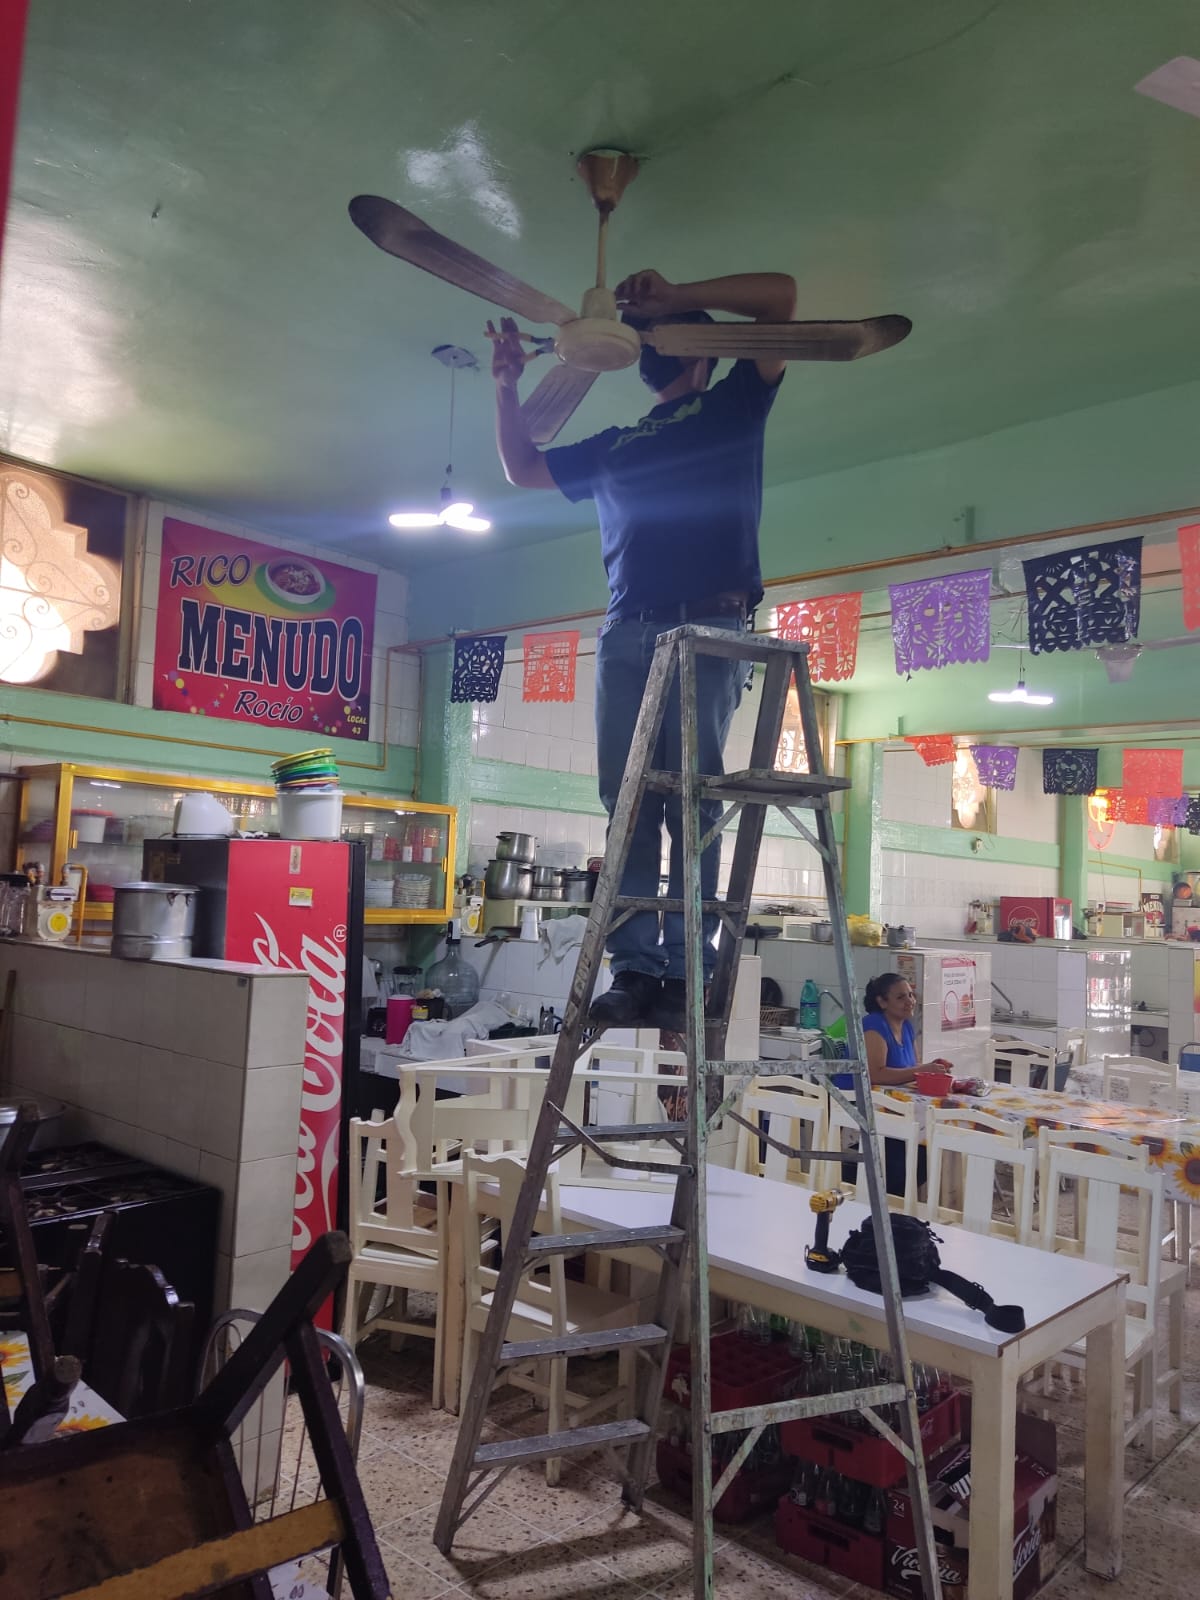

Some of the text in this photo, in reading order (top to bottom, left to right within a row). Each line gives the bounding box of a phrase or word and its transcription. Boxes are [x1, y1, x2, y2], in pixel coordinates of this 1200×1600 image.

[171, 554, 251, 588] RICO
[177, 598, 363, 701] MENUDO
[347, 715, 367, 724] LOCAL
